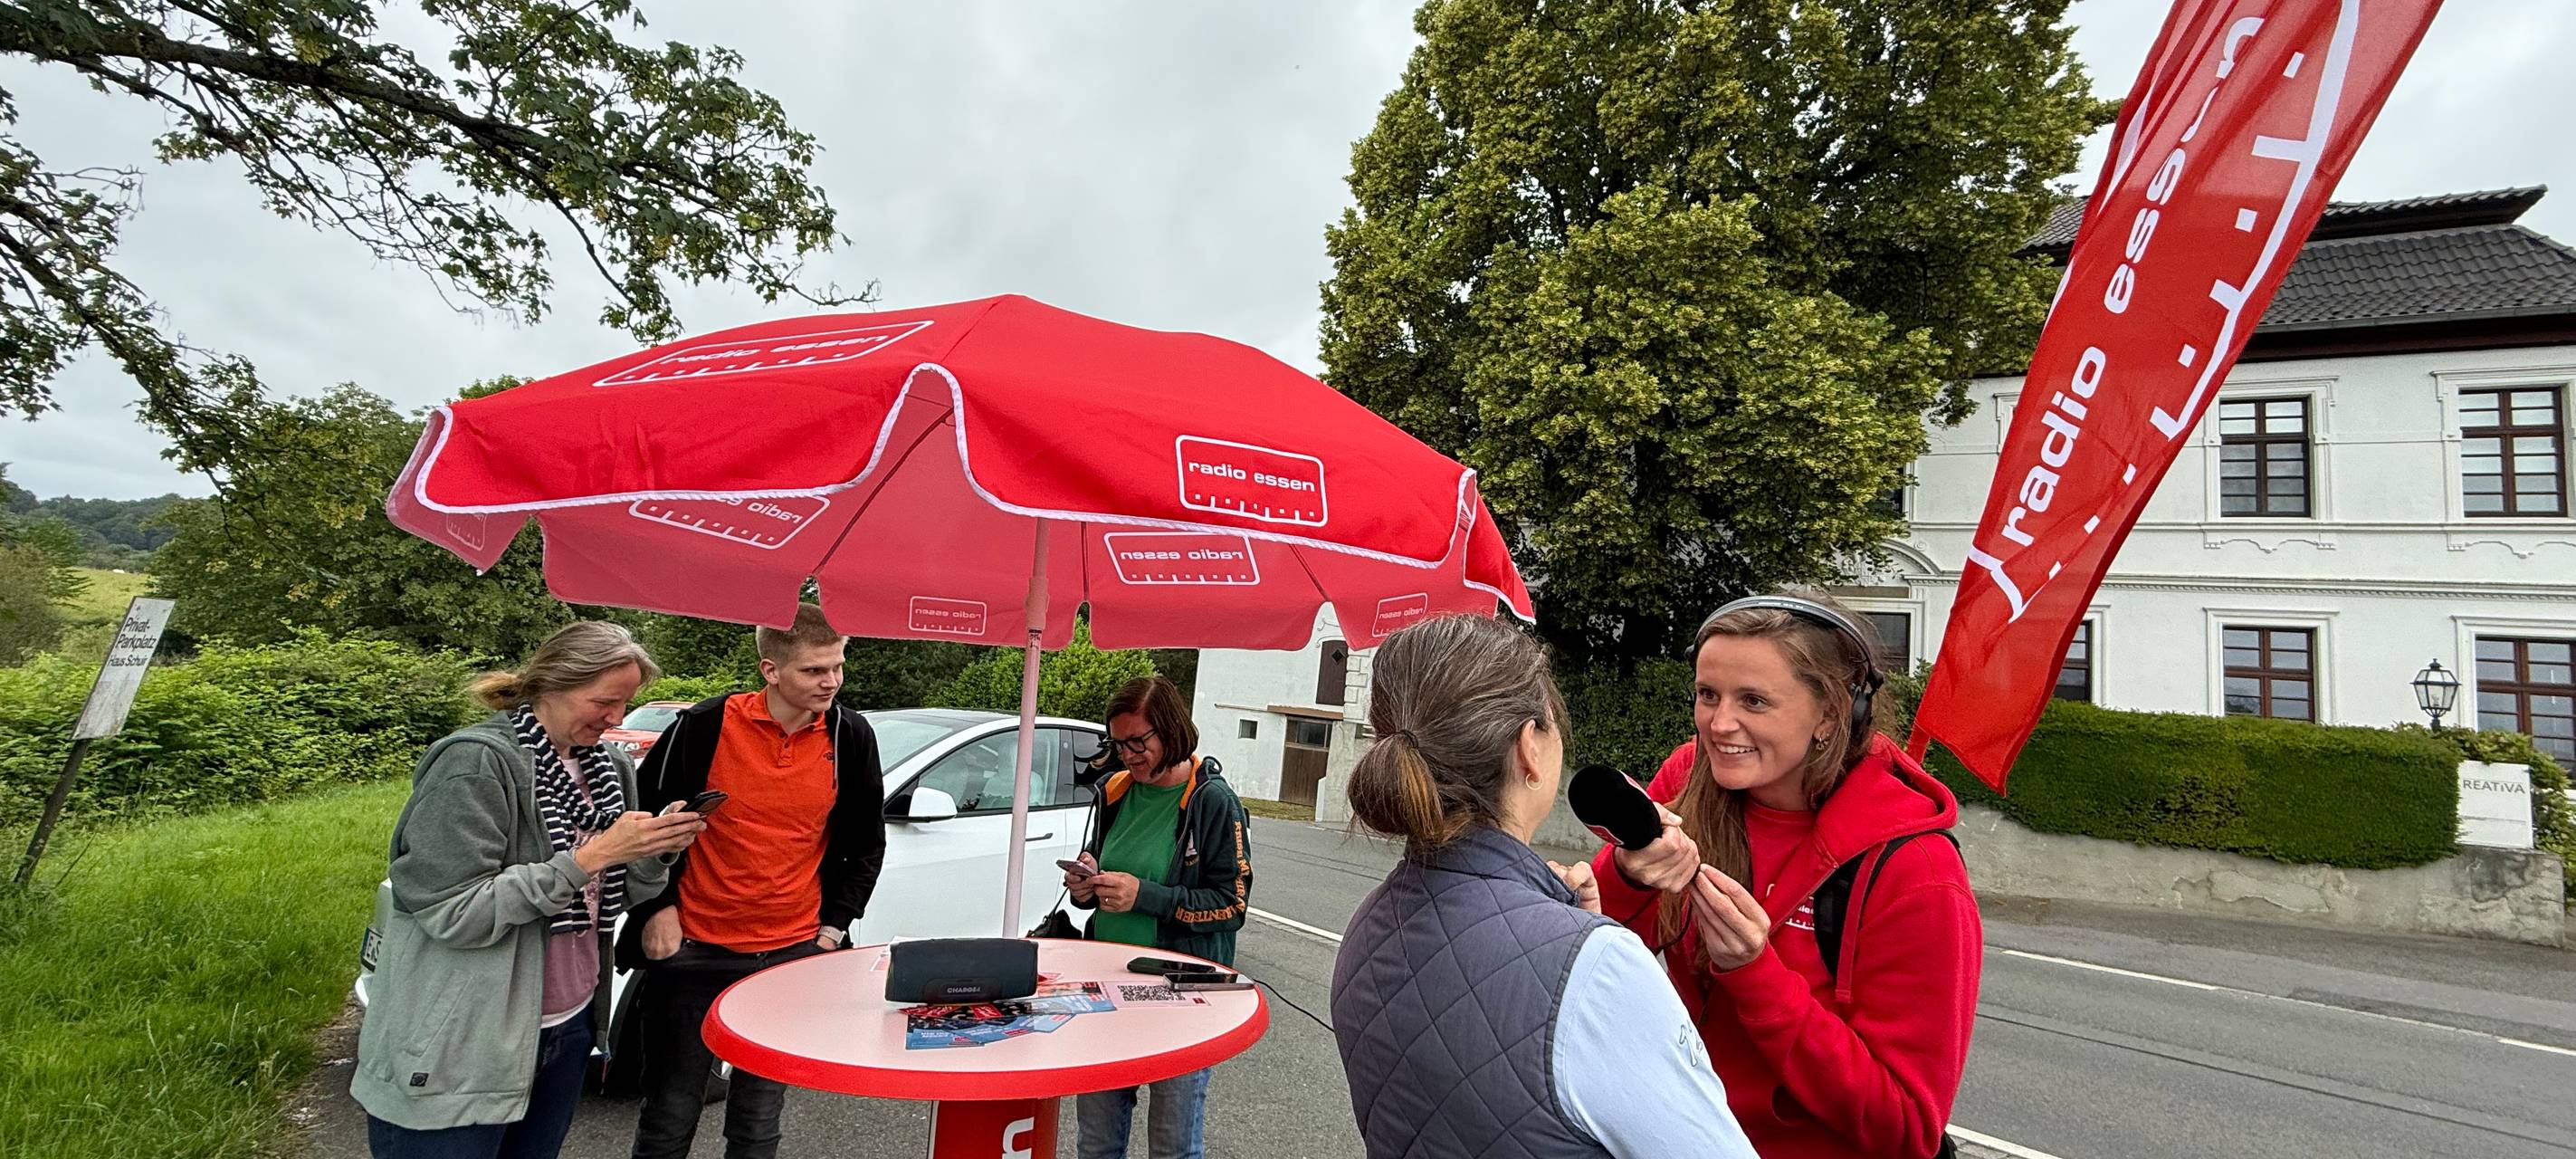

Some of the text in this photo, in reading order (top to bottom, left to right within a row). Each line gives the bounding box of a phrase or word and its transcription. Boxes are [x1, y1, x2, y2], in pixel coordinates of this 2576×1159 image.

[2001, 16, 2265, 547] radio essn
[660, 349, 761, 364] radio
[1188, 461, 1315, 492] radio essen
[123, 617, 150, 632] Privat-
[115, 634, 157, 652] Parkplatz
